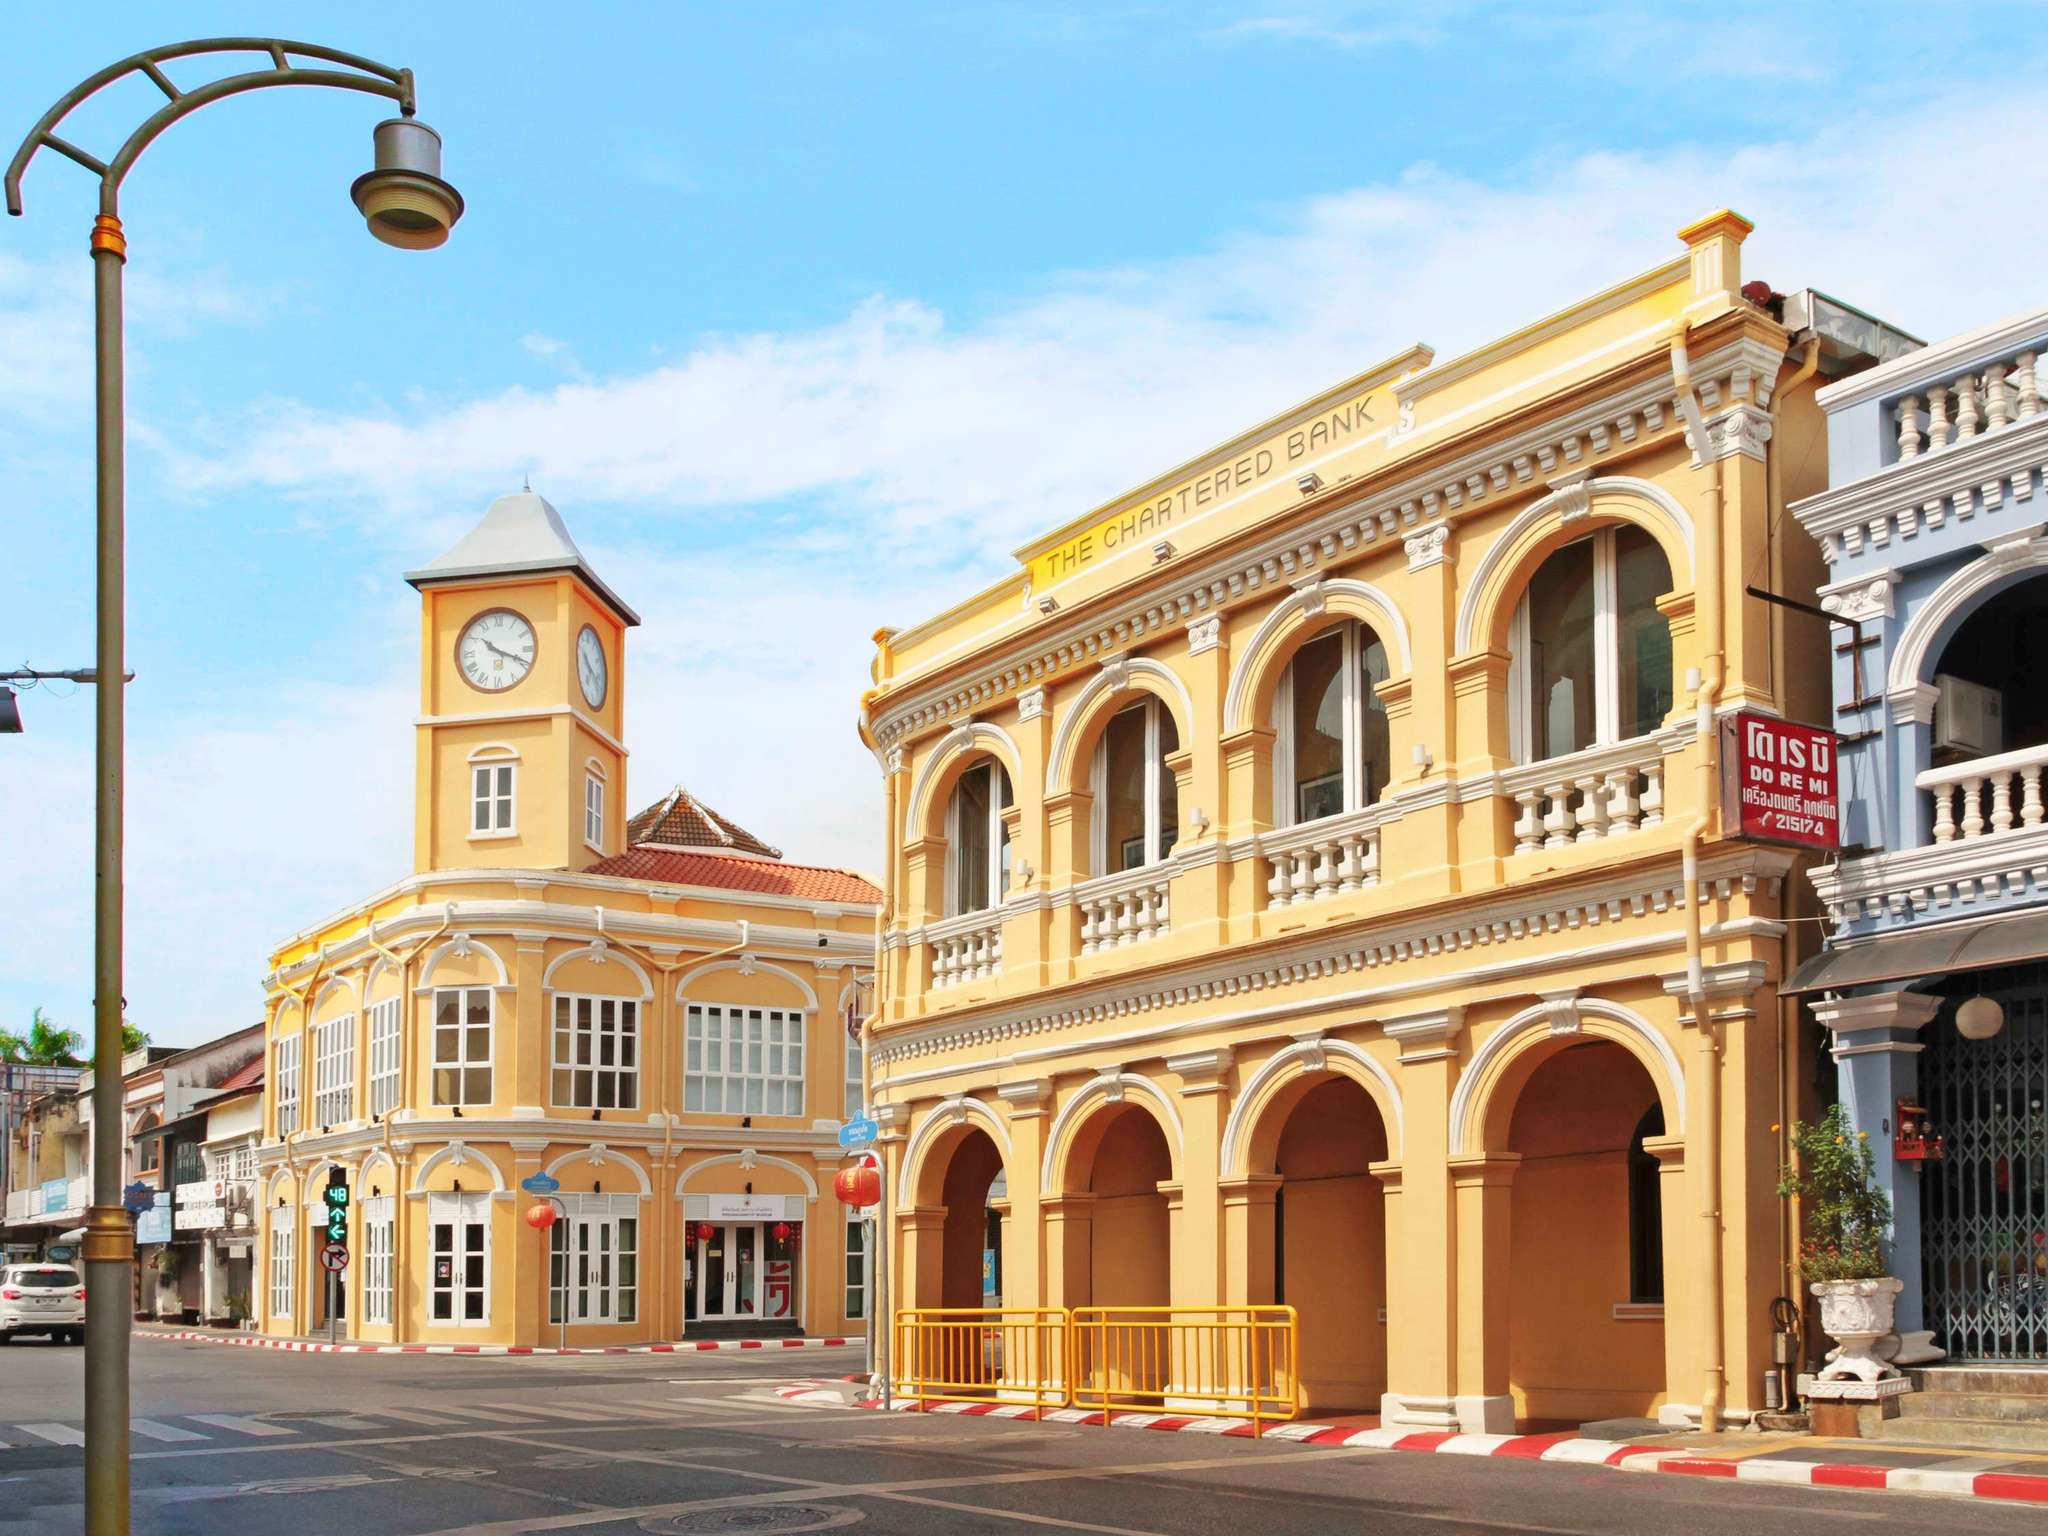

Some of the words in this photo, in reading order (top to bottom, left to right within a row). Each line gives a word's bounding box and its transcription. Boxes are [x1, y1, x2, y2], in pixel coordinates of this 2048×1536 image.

[1047, 535, 1093, 578] THE
[1103, 449, 1273, 548] CHARTERED
[1287, 395, 1375, 462] BANK
[1750, 764, 1774, 784] DO
[1780, 771, 1803, 790] RE
[1809, 777, 1828, 795] MI
[1775, 813, 1825, 836] 215174
[329, 1187, 347, 1202] 48
